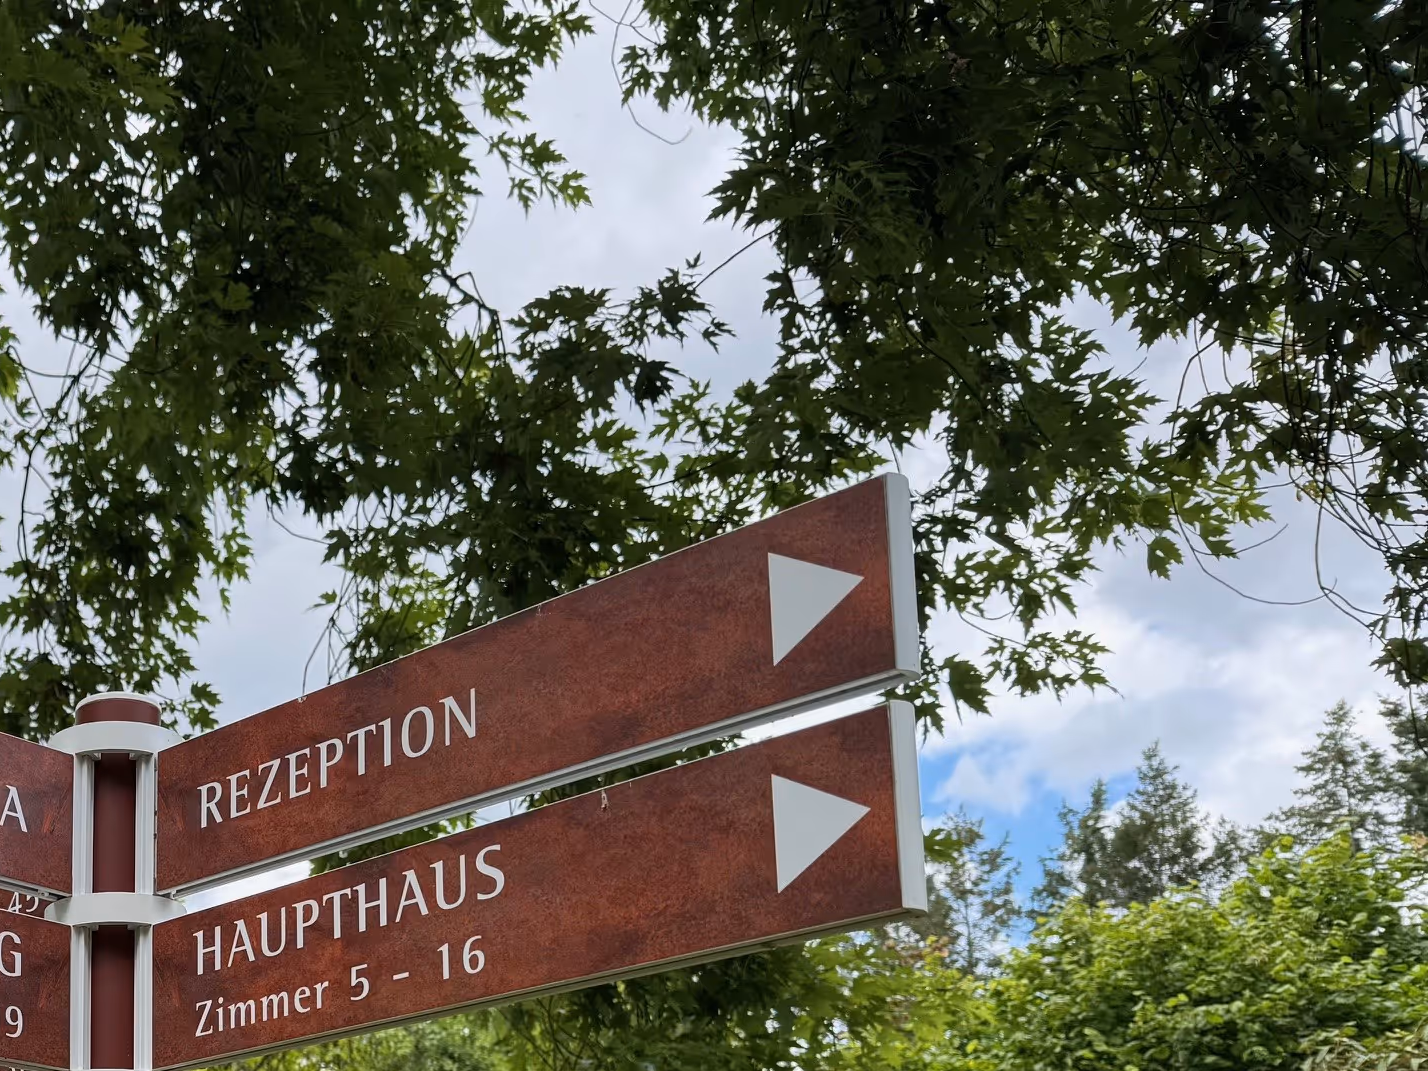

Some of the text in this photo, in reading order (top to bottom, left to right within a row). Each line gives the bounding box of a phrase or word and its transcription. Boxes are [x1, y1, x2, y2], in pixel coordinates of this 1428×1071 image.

[196, 687, 477, 829] REZEPTION
[192, 844, 506, 976] HAUPTHAUS
[194, 935, 486, 1037] Zimmer 5 - 16
